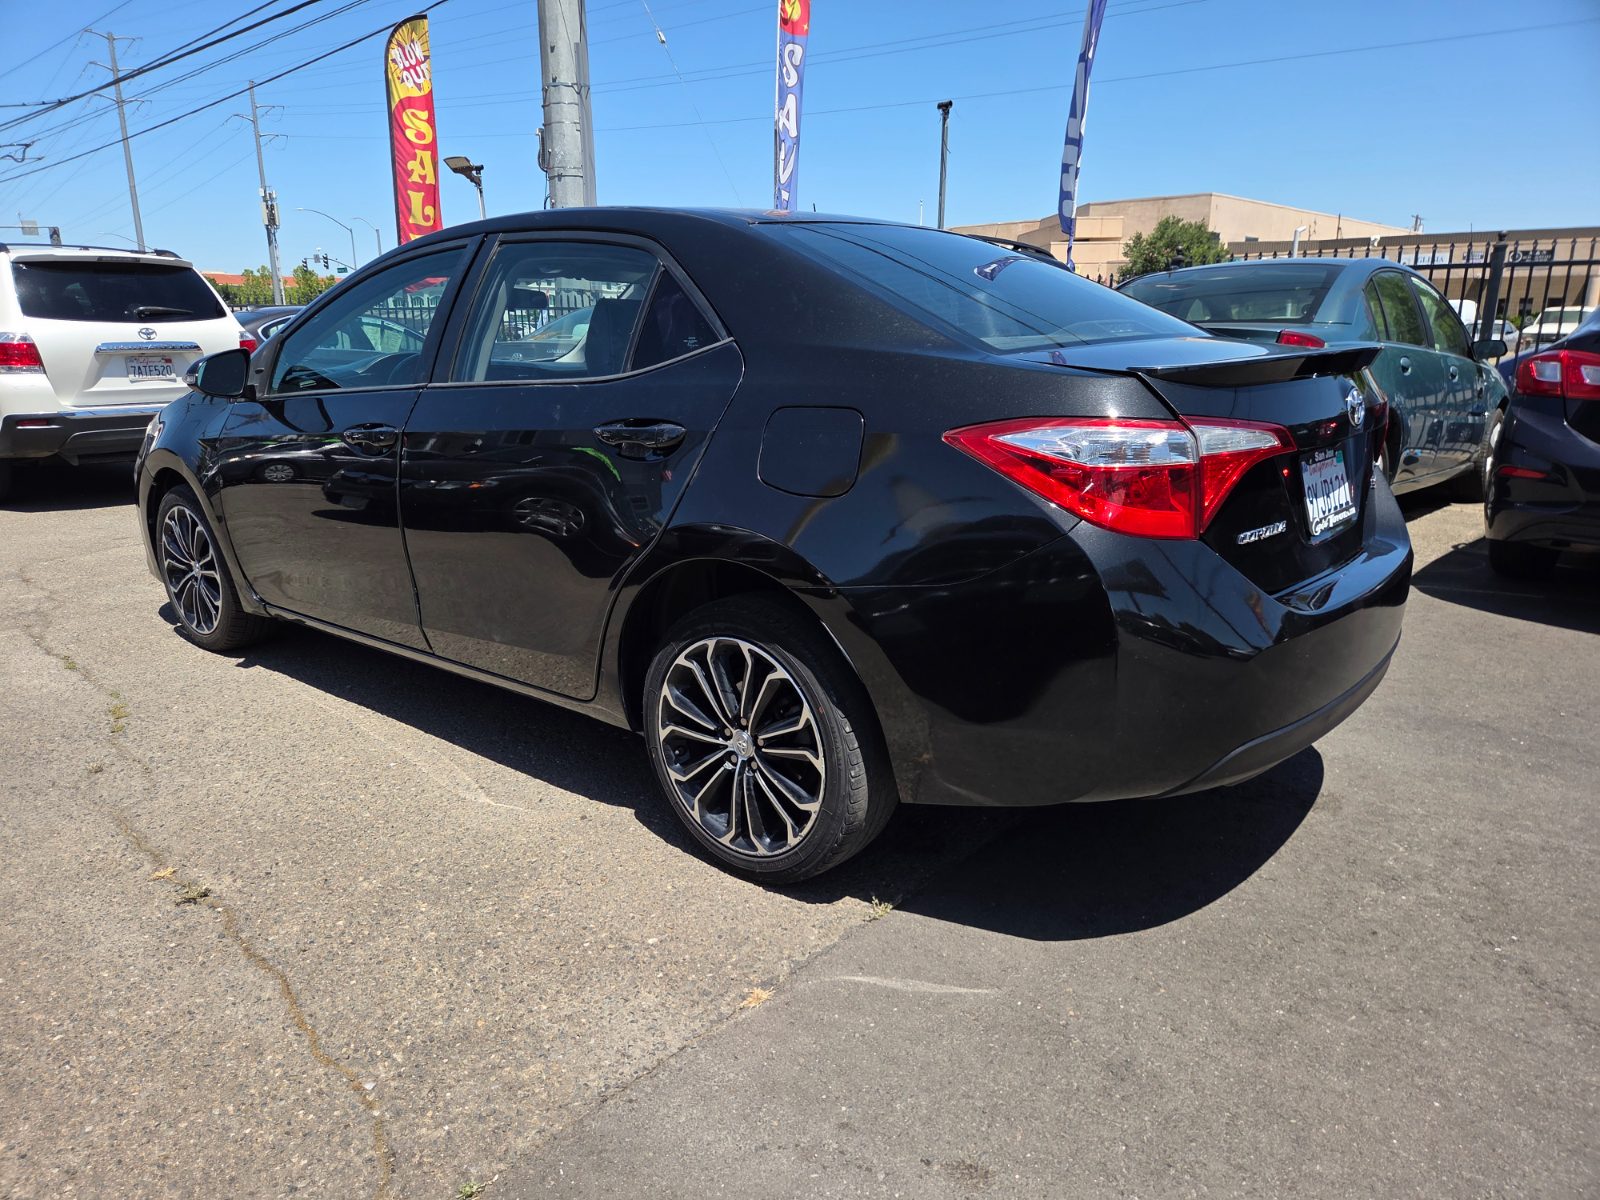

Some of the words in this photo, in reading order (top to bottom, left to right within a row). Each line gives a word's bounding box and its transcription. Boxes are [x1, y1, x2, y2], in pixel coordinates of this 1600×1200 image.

[391, 40, 425, 69] BLOW
[403, 63, 429, 88] OUT
[402, 108, 436, 240] SAL
